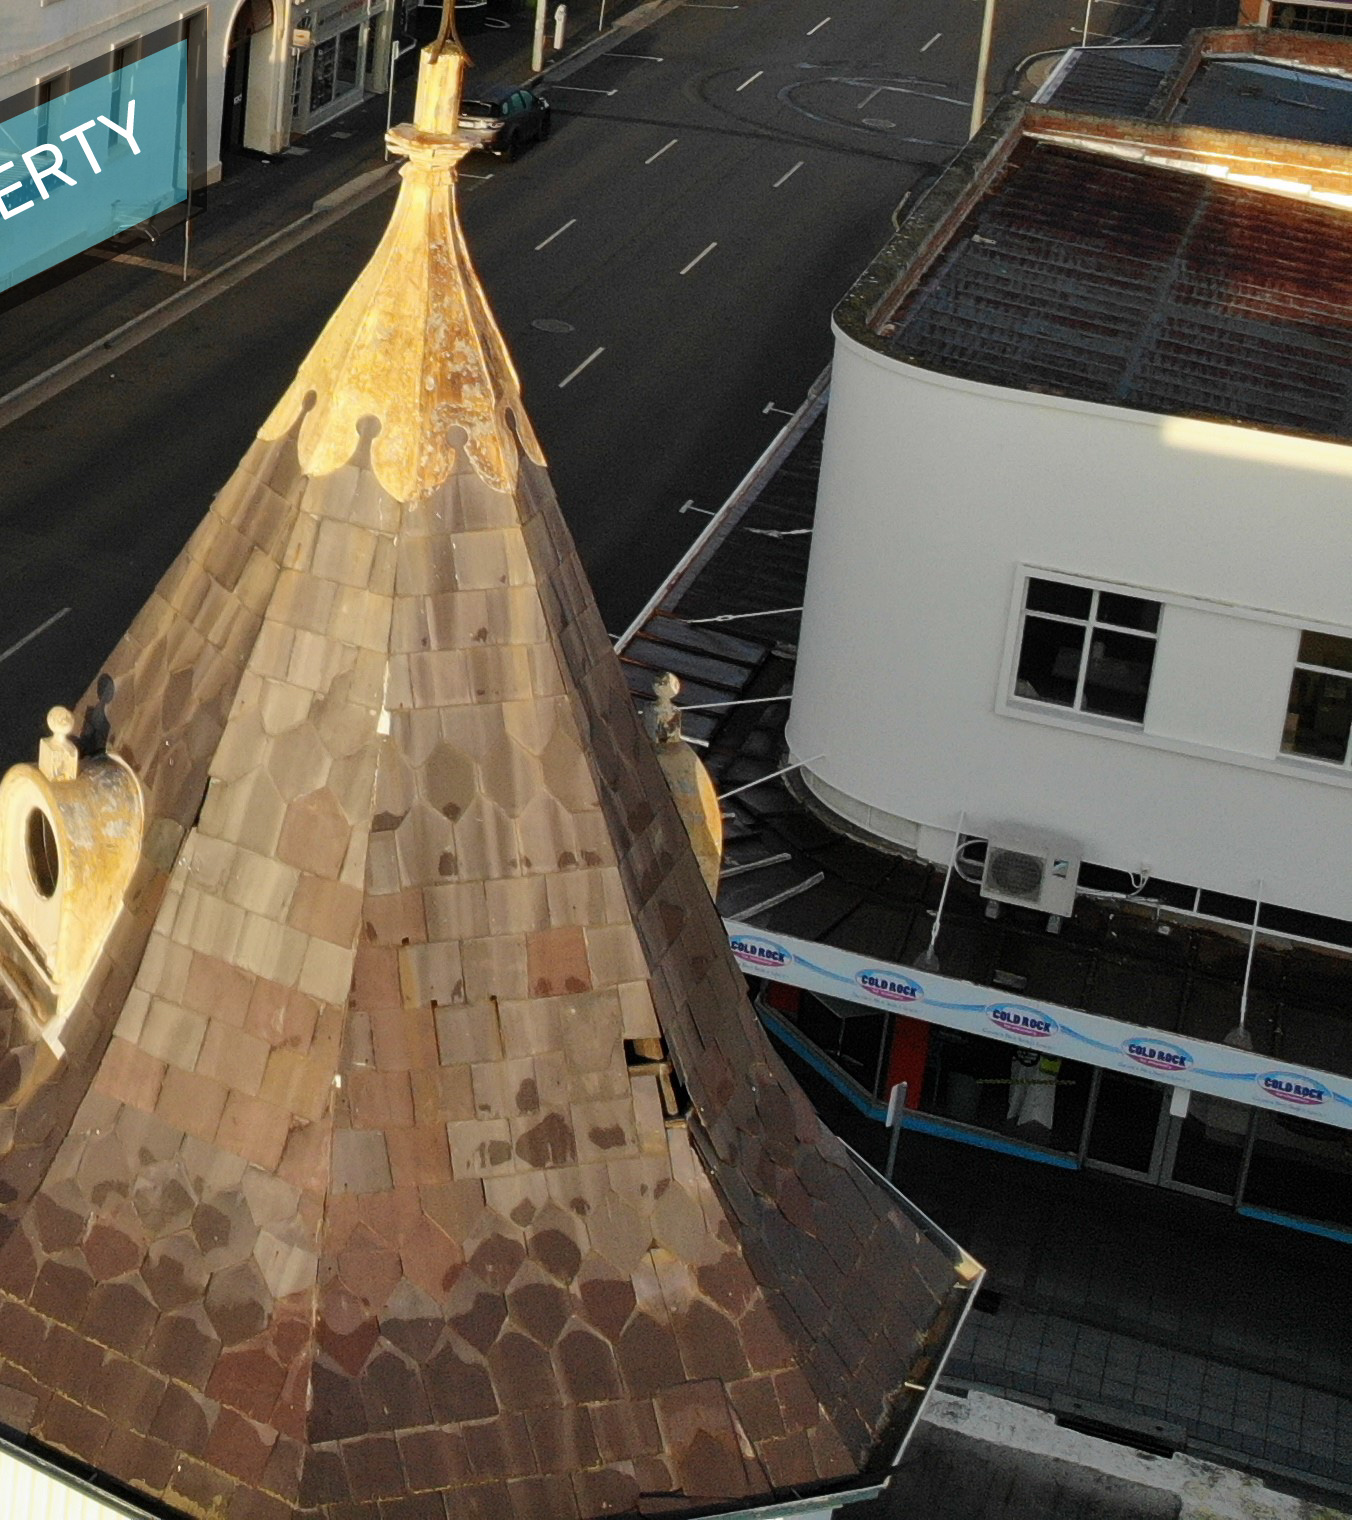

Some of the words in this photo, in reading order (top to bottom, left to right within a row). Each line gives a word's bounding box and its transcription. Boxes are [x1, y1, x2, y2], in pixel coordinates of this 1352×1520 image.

[731, 940, 757, 956] COLD
[757, 947, 785, 963] ROCK
[860, 974, 889, 991] COLD
[888, 982, 918, 998] ROCK
[992, 1008, 1021, 1027] COLD
[1022, 1015, 1051, 1033] ROCK
[1128, 1043, 1156, 1059] COLD
[1157, 1050, 1186, 1067] ROCK
[1263, 1076, 1293, 1094] COLD
[1293, 1083, 1325, 1102] ROCK
